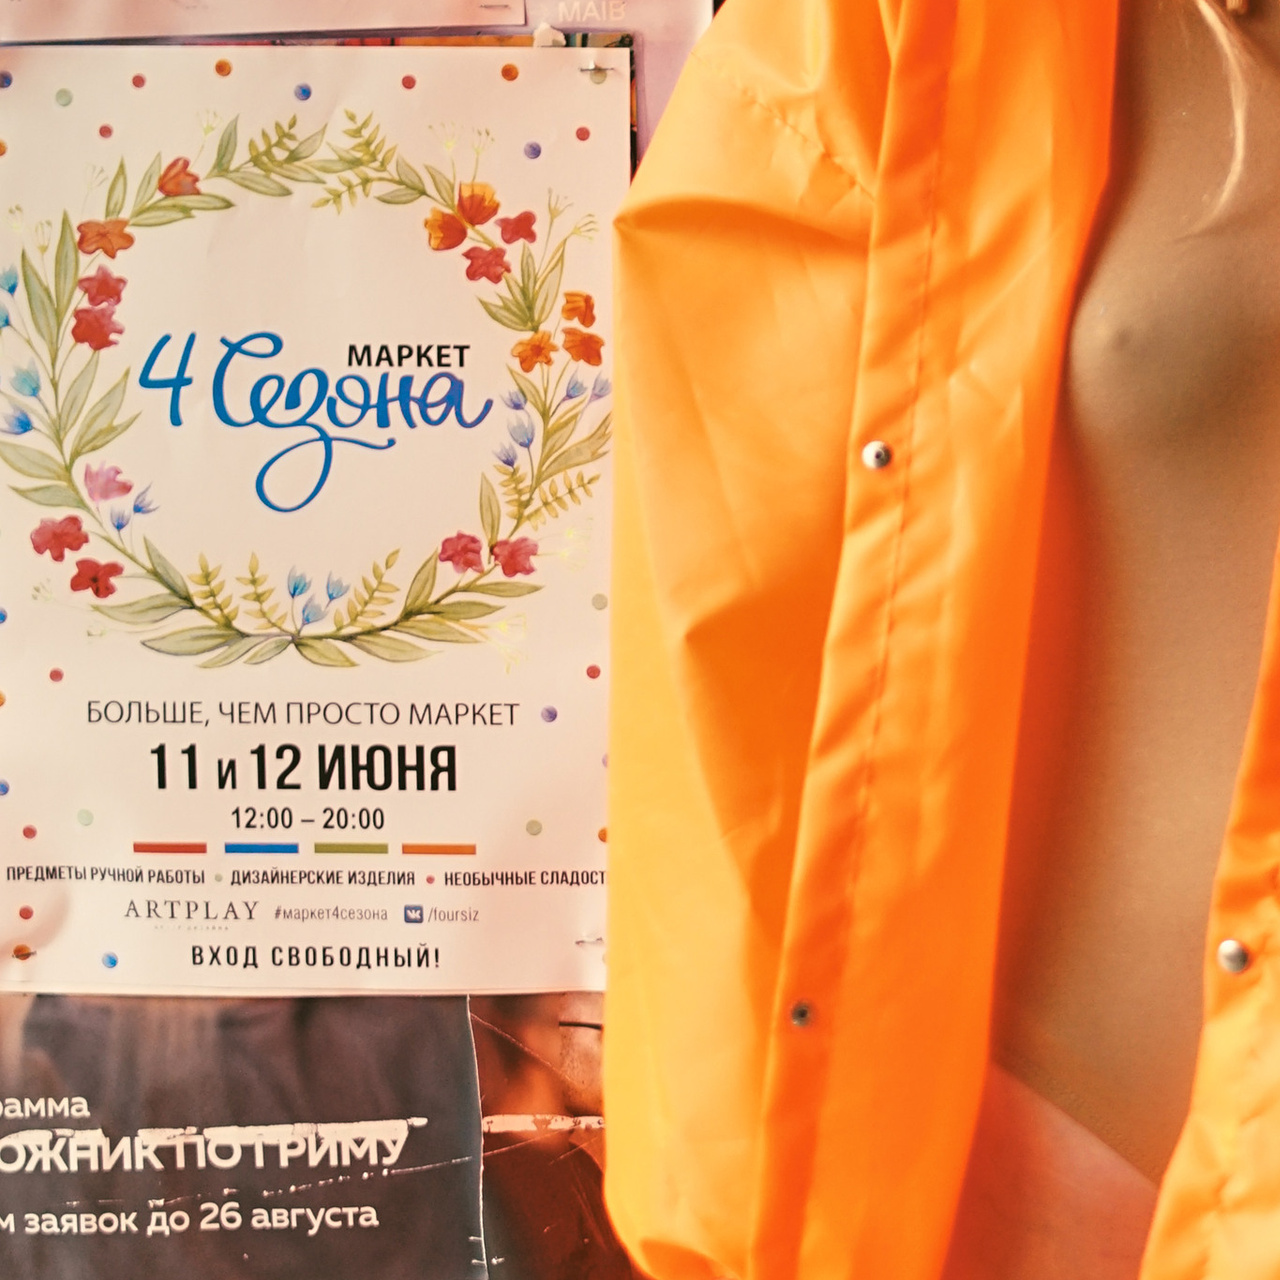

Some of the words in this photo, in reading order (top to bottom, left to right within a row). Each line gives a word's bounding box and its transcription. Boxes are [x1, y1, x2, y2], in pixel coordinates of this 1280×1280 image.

[347, 343, 471, 369] МАРКЕТ
[138, 331, 197, 427] 4
[212, 330, 494, 513] Сезона
[86, 699, 209, 727] БОЛЬШЕ,
[217, 700, 277, 725] ЧЕМ
[285, 700, 401, 726] ПРОСТО
[409, 701, 521, 727] МАРКЕТ
[150, 741, 200, 791] 11
[216, 754, 237, 790] и
[249, 742, 302, 791] 12
[317, 743, 458, 793] ИЮНЯ
[230, 805, 294, 830] 12:00
[321, 806, 386, 831] 20:00
[6, 864, 88, 883] ПРЕДМЕТЫ
[90, 863, 145, 884] РУЧНОЙ
[146, 868, 207, 886] РАБОТЫ
[230, 865, 343, 888] ДИЗАЙНЕРСКИЕ
[346, 868, 416, 888] ИЗДЕЛИЯ
[443, 869, 537, 888] НЕОБЫЧНЫЕ
[123, 898, 261, 921] ARTPLAY
[273, 903, 389, 924] #маркет4сезона
[191, 944, 260, 970] ВХОД
[270, 940, 441, 970] СВОБОДНЫЙ!
[24, 1211, 138, 1234] заявок
[146, 1211, 191, 1238] до
[199, 1201, 243, 1231] 26
[250, 1204, 381, 1238] августа
